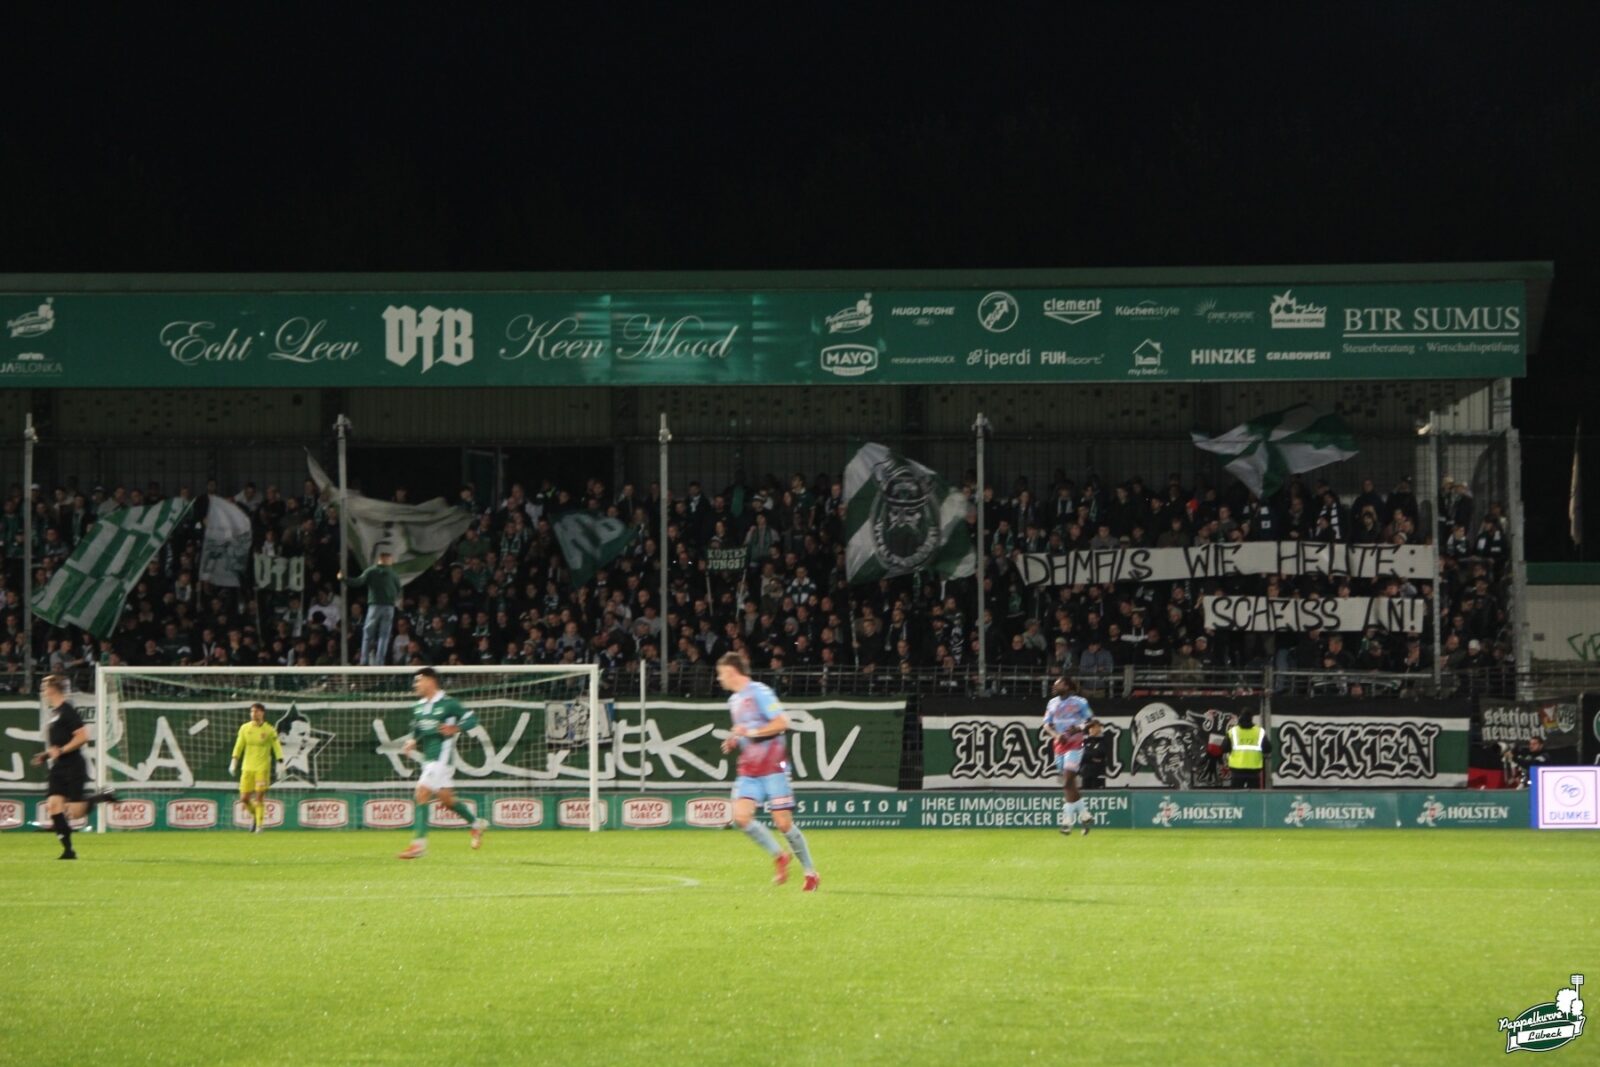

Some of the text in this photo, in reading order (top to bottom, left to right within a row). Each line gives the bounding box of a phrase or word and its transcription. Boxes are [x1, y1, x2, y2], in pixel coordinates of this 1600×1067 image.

[1043, 297, 1102, 311] clement
[1343, 306, 1520, 331] BTR SUMUS
[160, 316, 361, 366] Echt Leev
[381, 305, 474, 374] VfB
[500, 313, 739, 360] Keen Mood
[826, 351, 872, 364] MAYO
[984, 349, 1031, 368] iperdi
[1191, 348, 1256, 364] HINZKE
[1266, 351, 1331, 361] GRABOWSKI
[1022, 549, 1152, 585] DAMALS
[1185, 544, 1241, 578] WIE
[1212, 596, 1341, 630] SCHEISS
[113, 804, 146, 813] MAYO
[176, 804, 209, 813] MAYO
[307, 804, 340, 812] MAYO
[372, 804, 406, 812] MAYO
[501, 803, 535, 811] MAYO
[566, 803, 590, 811] MAY
[630, 803, 663, 811] MAYO
[694, 803, 727, 811] MAYO
[921, 797, 956, 810] IHRE
[921, 812, 937, 825] IN
[942, 812, 972, 825] DER
[976, 809, 1052, 826] LÜBECKER
[1182, 807, 1244, 820] HOLSTEN
[1315, 807, 1377, 820] HOLSTEN
[1447, 807, 1509, 820] HOLSTEN
[1549, 810, 1591, 820] DUMKE
